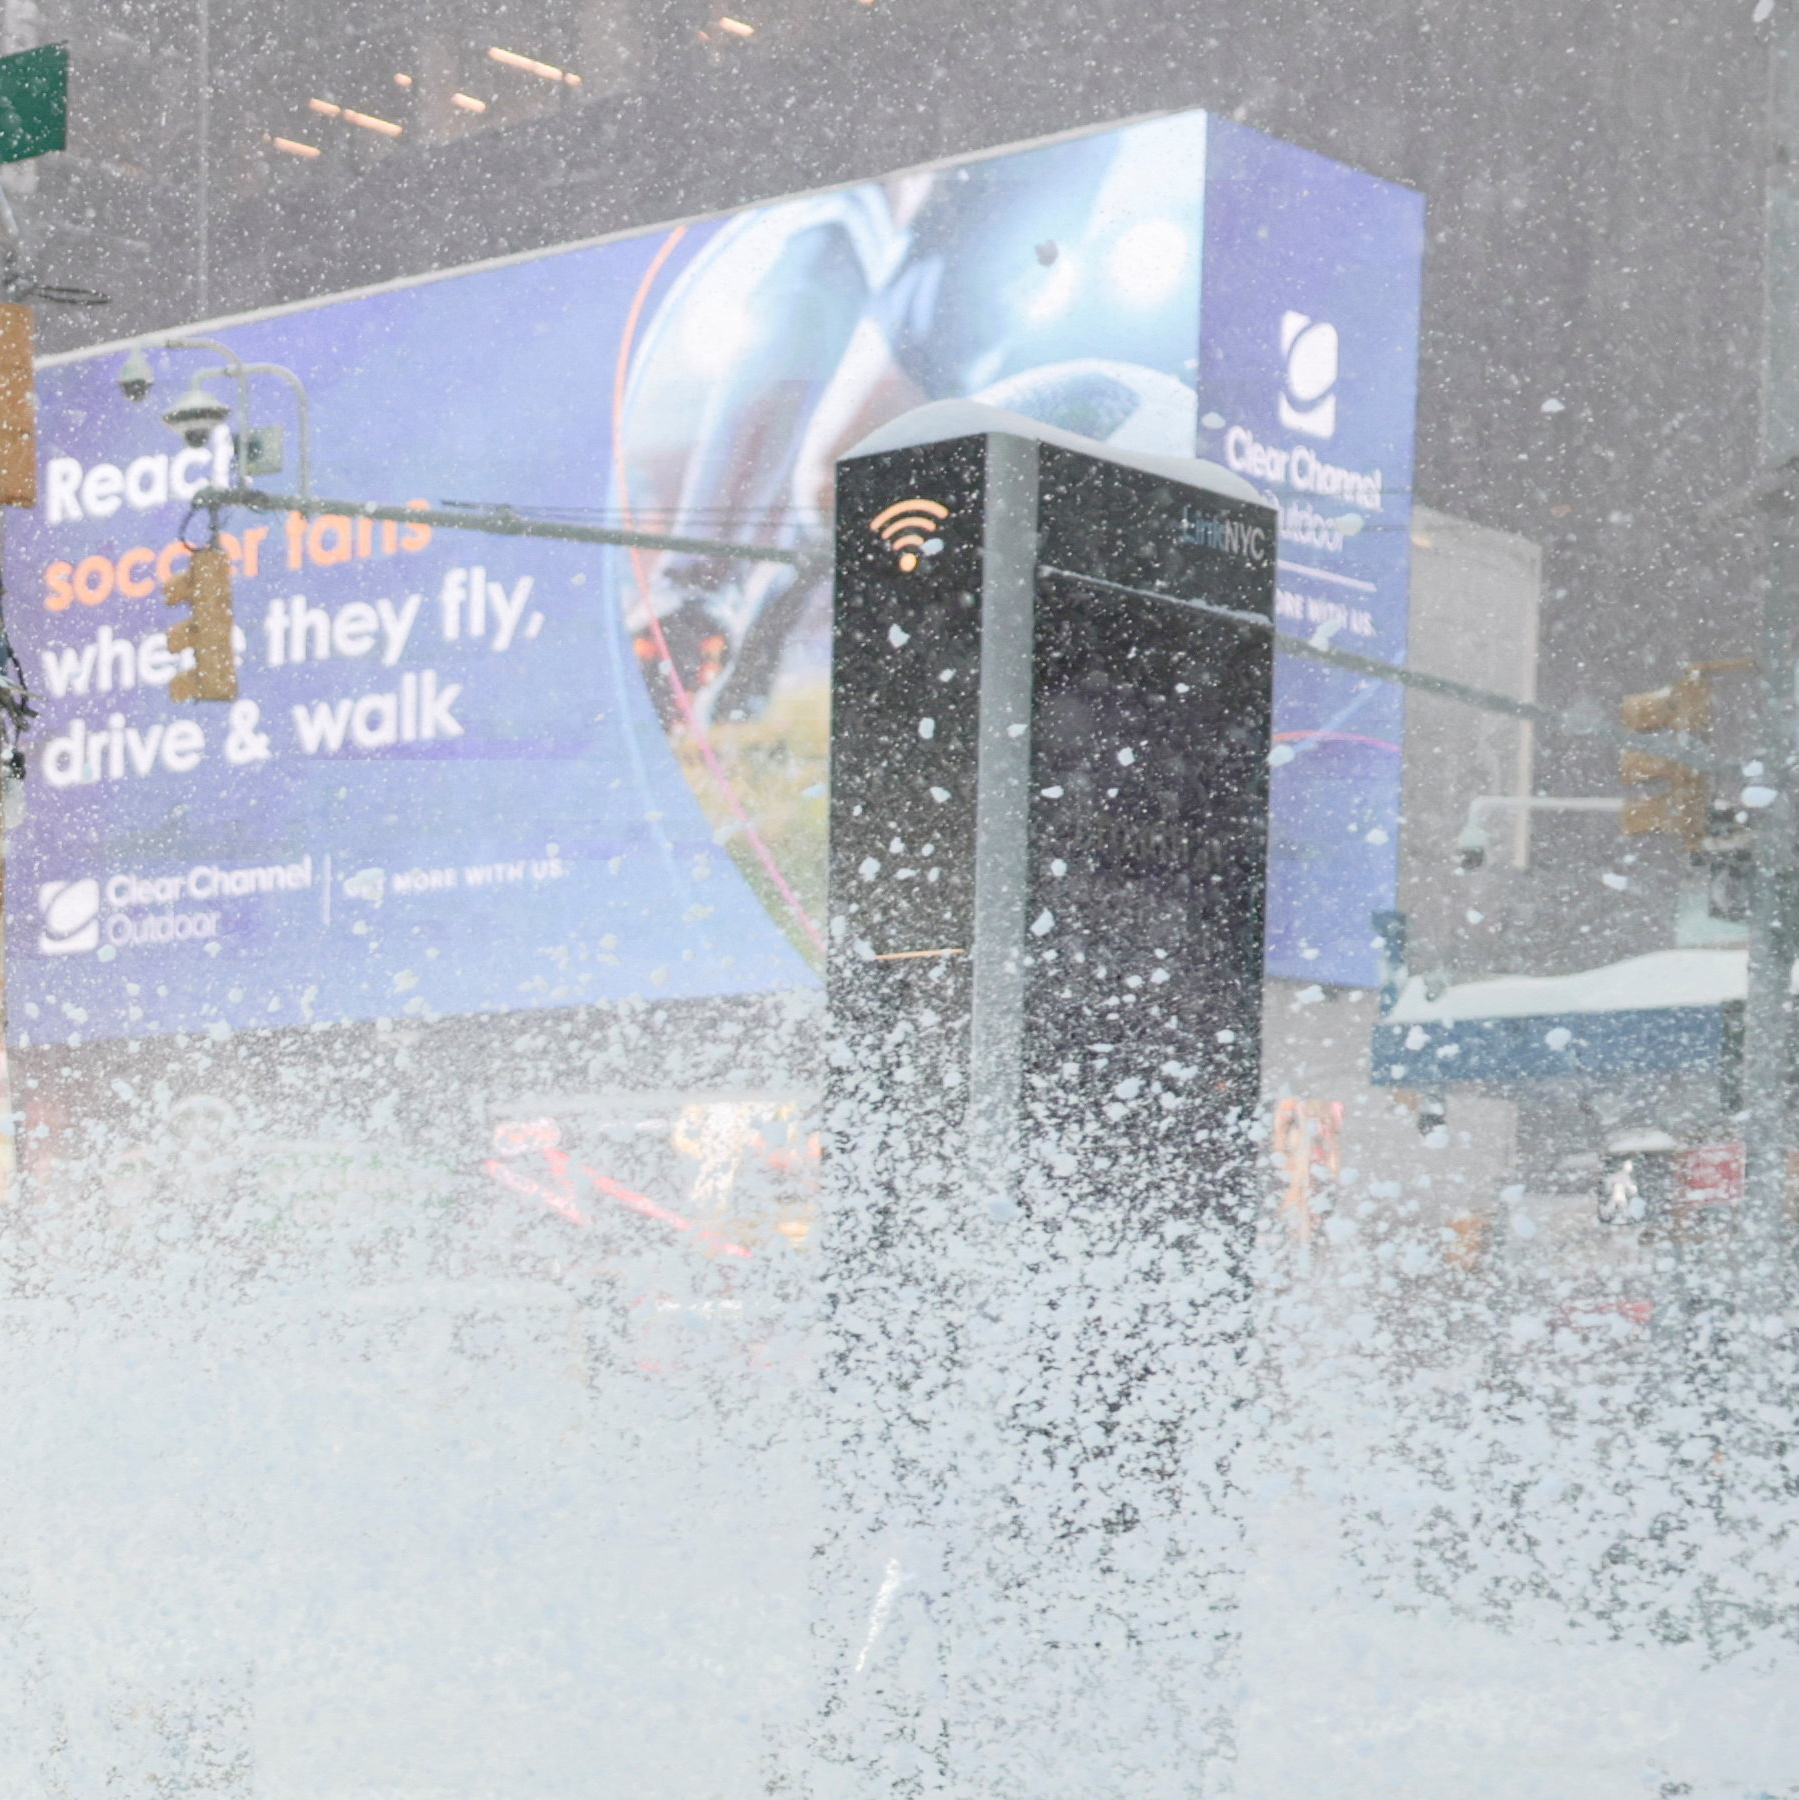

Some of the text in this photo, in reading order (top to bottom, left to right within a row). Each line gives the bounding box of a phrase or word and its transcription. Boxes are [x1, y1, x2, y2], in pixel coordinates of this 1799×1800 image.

[1225, 424, 1383, 512] Clear Channel
[1181, 505, 1266, 560] LinkNYC
[265, 595, 424, 667] they
[436, 566, 546, 652] fly,
[42, 669, 465, 787] drive & walk
[106, 874, 186, 907] Clear
[187, 854, 313, 899] Channel
[105, 910, 221, 949] Outdoor
